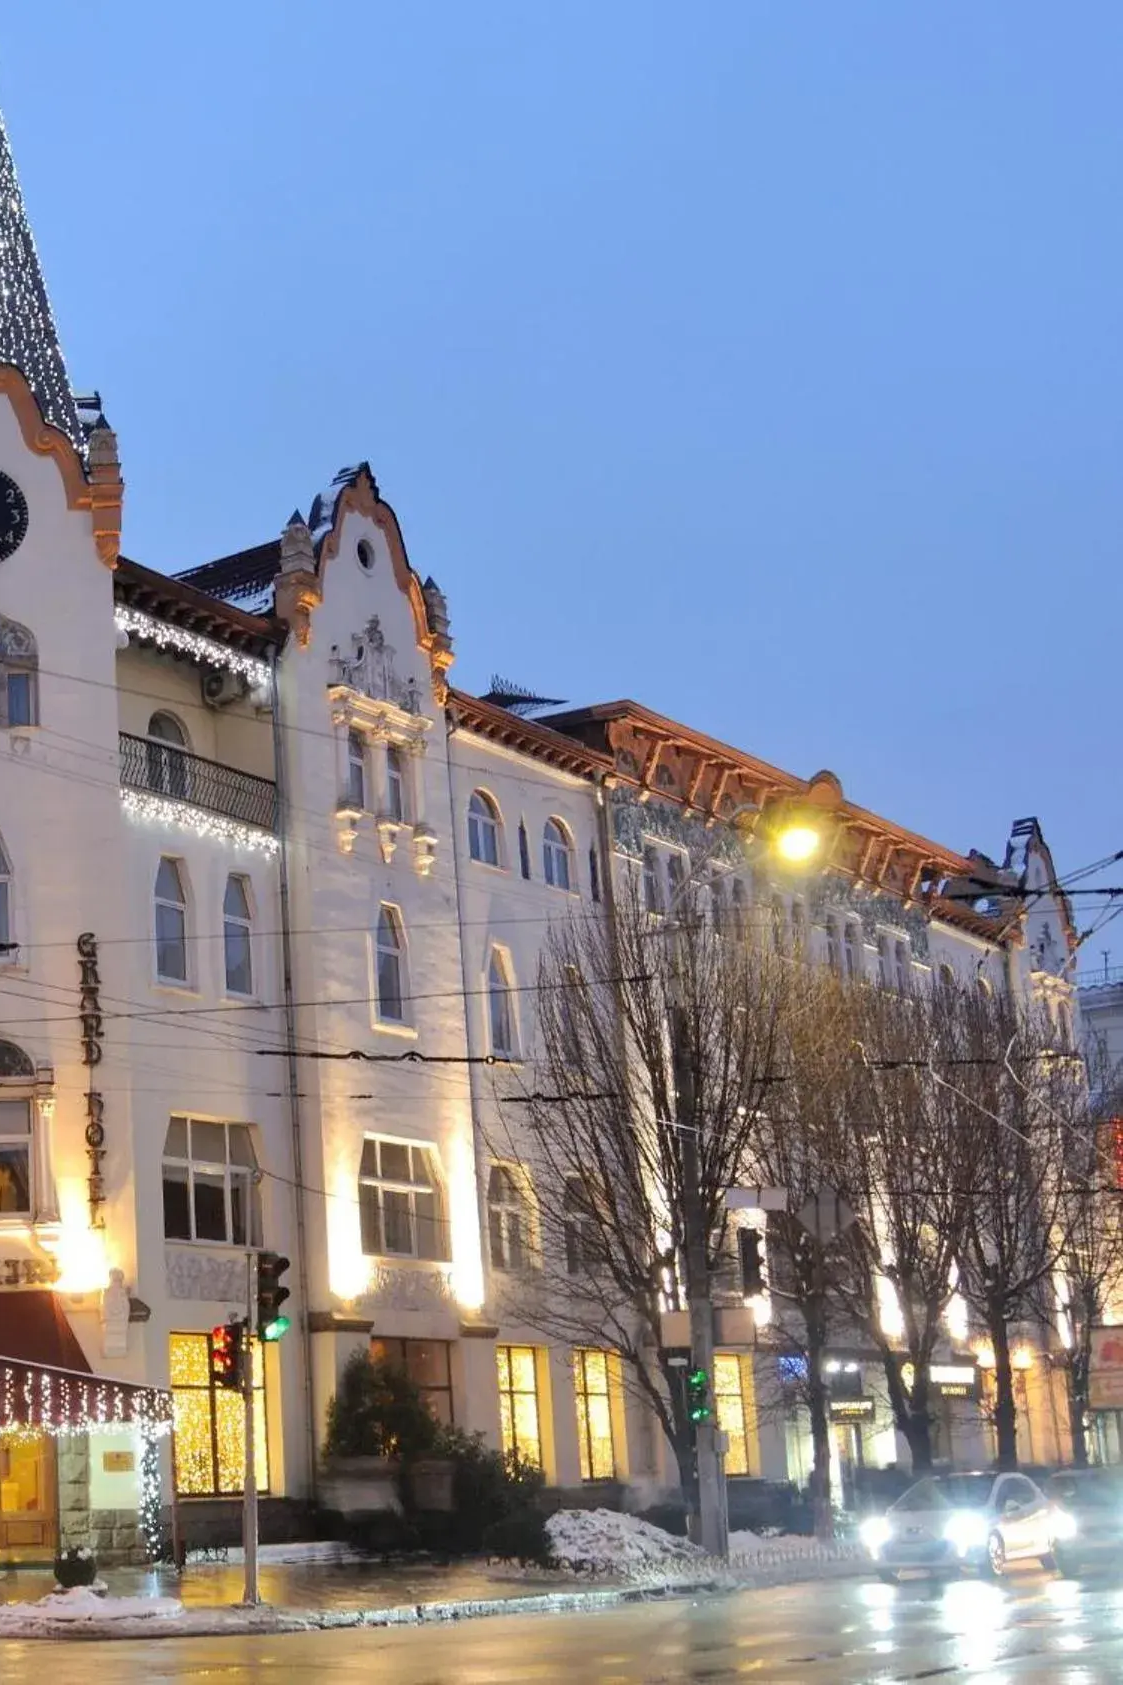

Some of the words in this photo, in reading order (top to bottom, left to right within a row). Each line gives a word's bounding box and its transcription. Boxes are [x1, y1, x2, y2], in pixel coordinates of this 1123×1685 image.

[5, 489, 15, 502] 2
[10, 509, 20, 524] 3
[4, 530, 14, 543] 4
